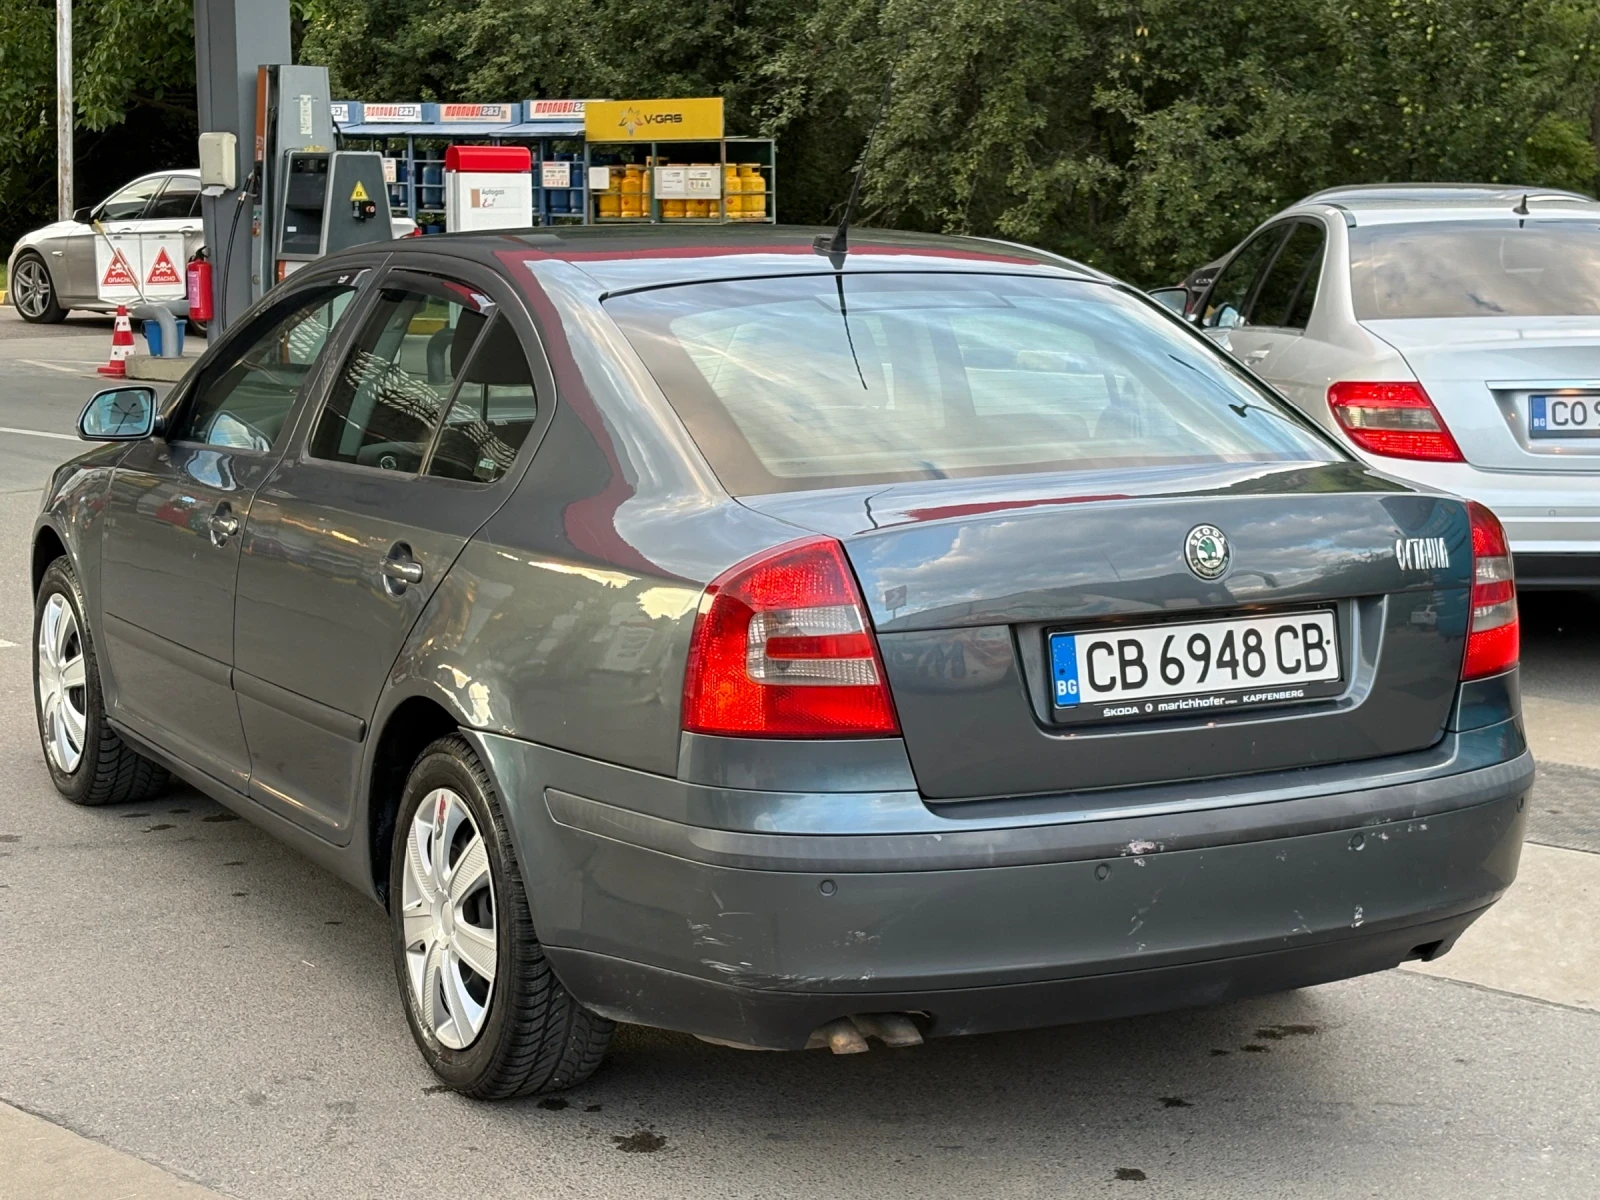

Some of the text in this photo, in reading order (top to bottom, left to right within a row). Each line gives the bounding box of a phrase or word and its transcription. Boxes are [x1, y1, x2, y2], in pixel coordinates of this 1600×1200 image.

[644, 114, 682, 125] V-GAS
[151, 275, 176, 283] ОПАСНО
[1395, 537, 1450, 571] OCTAVIA
[1086, 638, 1149, 693] CB
[1160, 627, 1266, 687] 6948
[1056, 679, 1078, 696] BG
[1103, 706, 1140, 717] ŠKODA
[1158, 697, 1226, 712] marichhofer
[1242, 689, 1305, 703] KAPFENBERG
